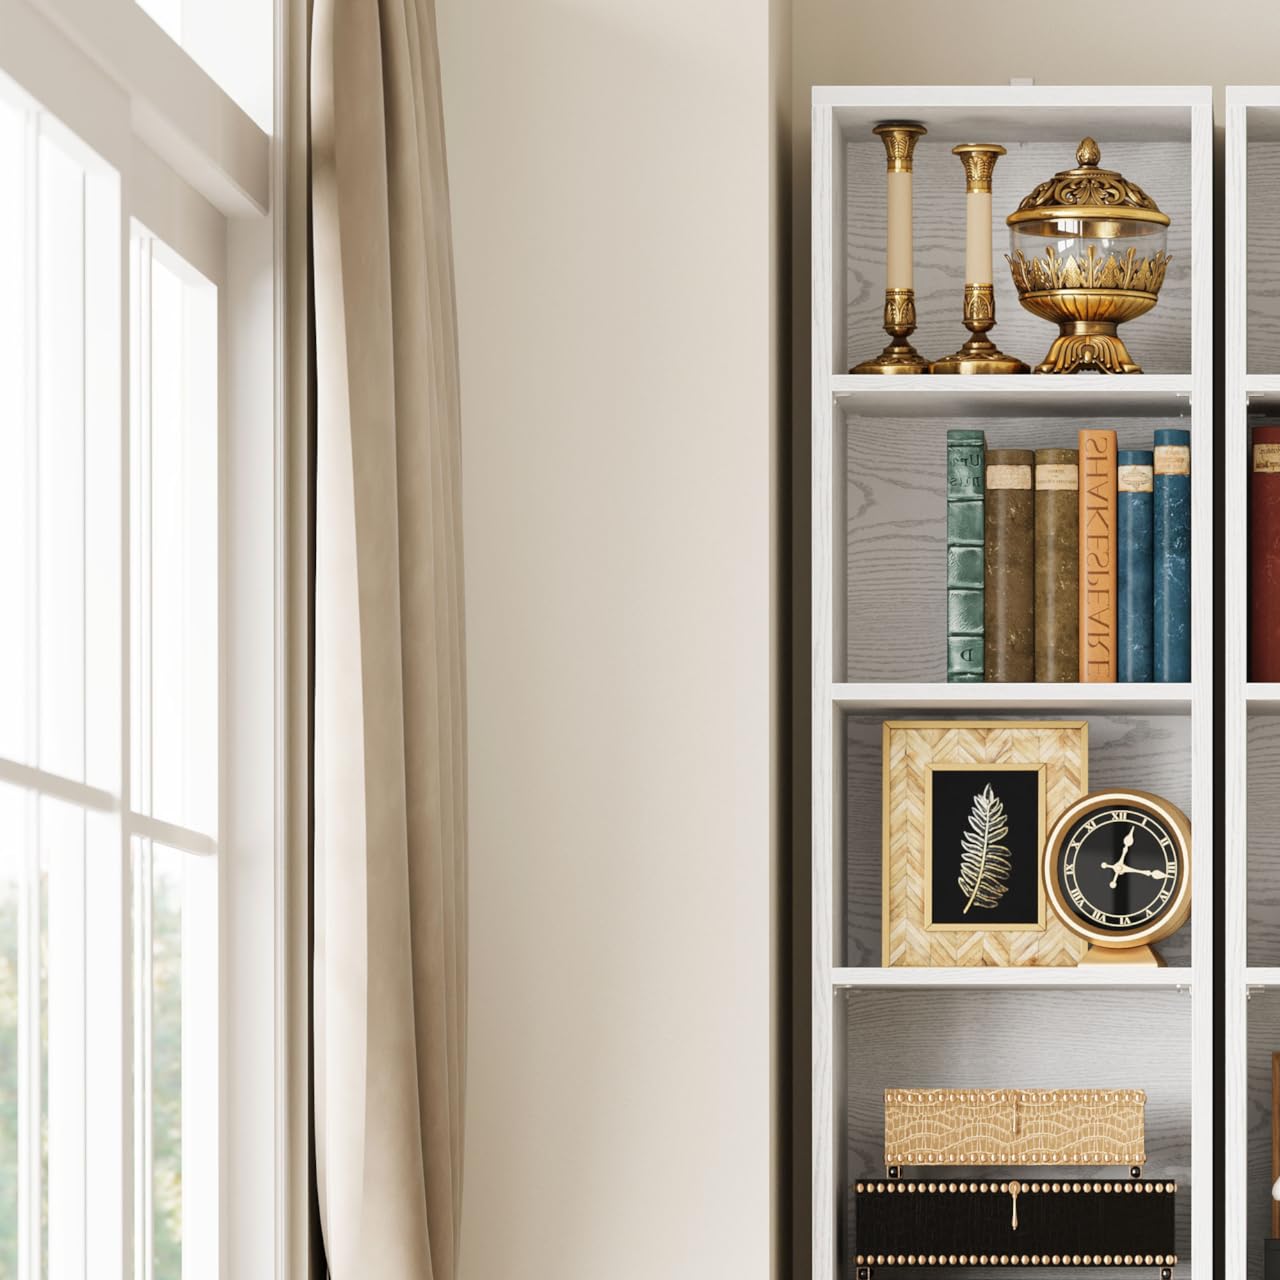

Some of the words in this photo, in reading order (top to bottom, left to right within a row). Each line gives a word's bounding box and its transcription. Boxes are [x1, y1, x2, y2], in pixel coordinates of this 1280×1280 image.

[1111, 812, 1128, 821] XII
[1085, 820, 1098, 832] XI
[1141, 817, 1148, 826] I
[1070, 840, 1081, 849] X
[1160, 836, 1170, 846] II
[1159, 890, 1170, 903] IV
